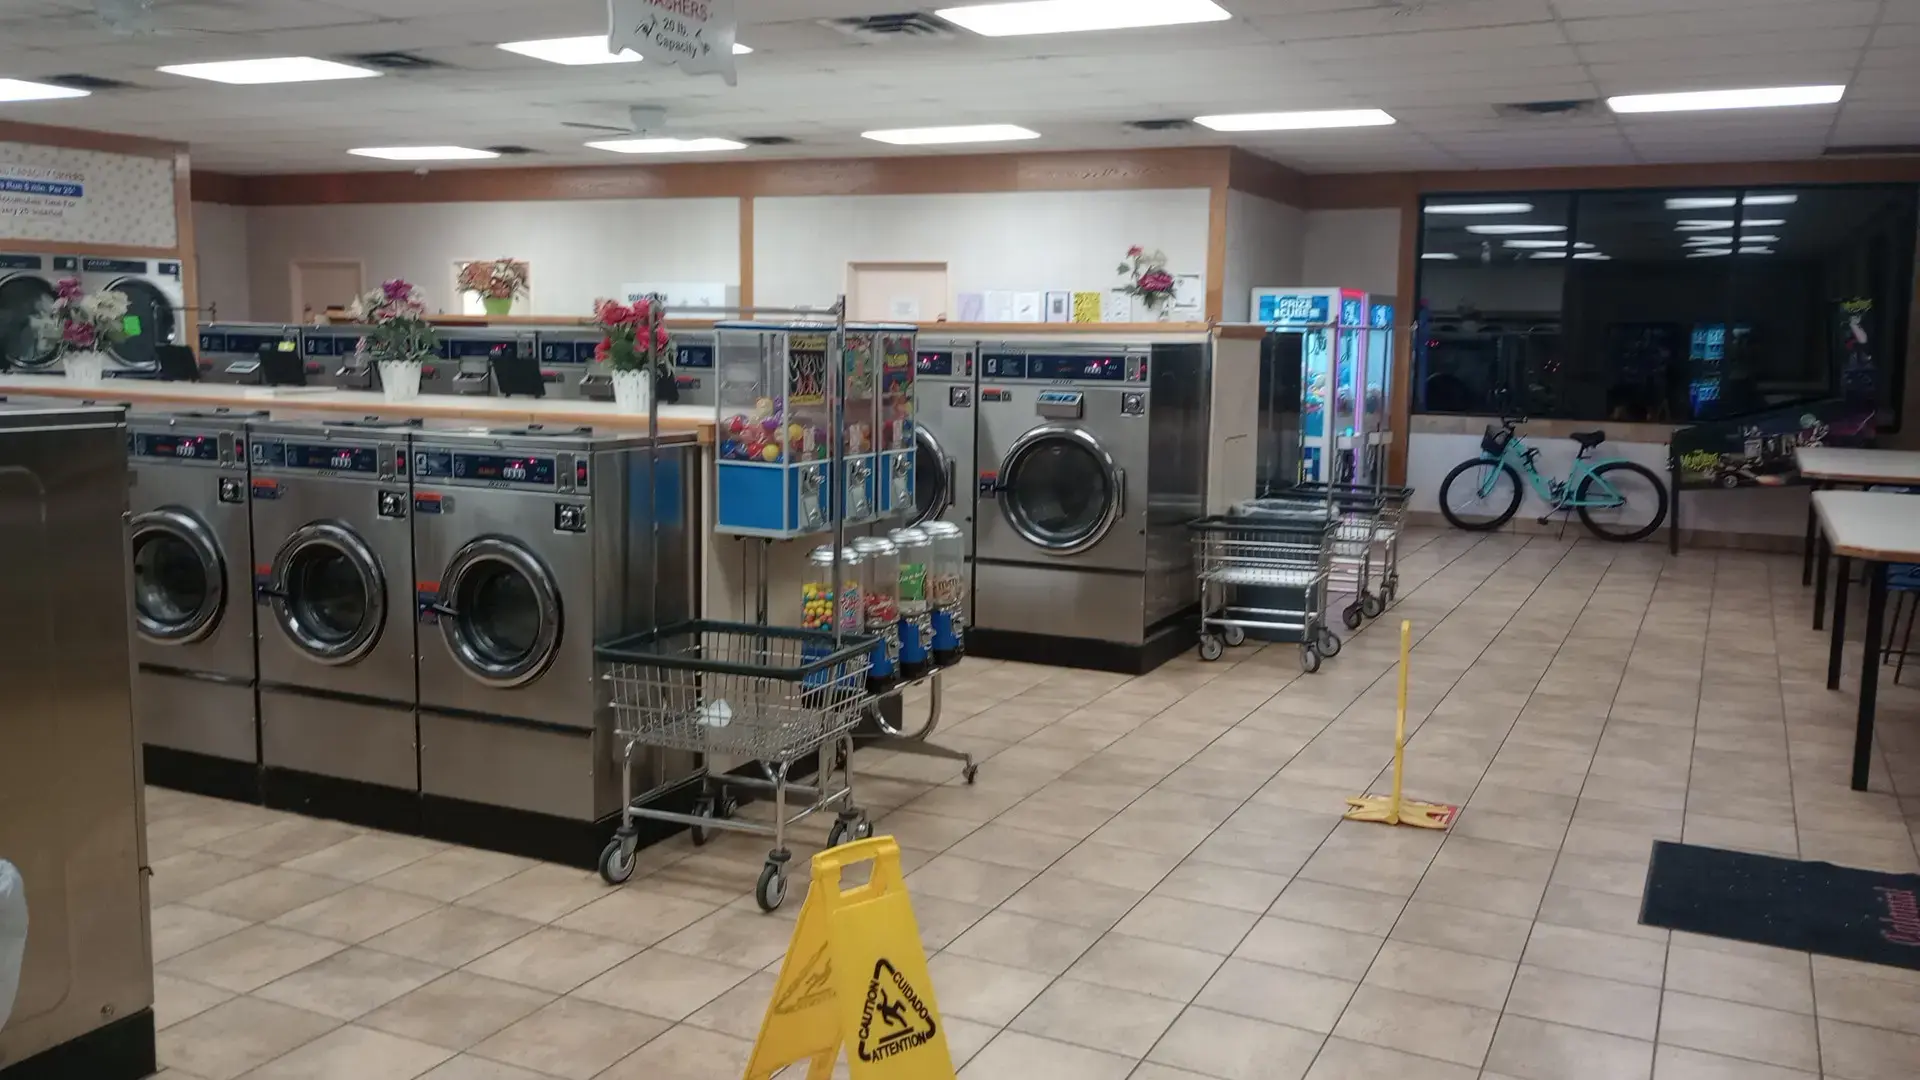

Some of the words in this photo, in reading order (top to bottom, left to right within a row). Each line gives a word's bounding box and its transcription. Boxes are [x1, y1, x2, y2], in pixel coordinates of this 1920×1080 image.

[656, 32, 697, 59] Capacity
[858, 979, 880, 1040] CAUTION
[892, 971, 928, 1019] CUIDADO
[871, 1031, 927, 1063] ATTENTION
